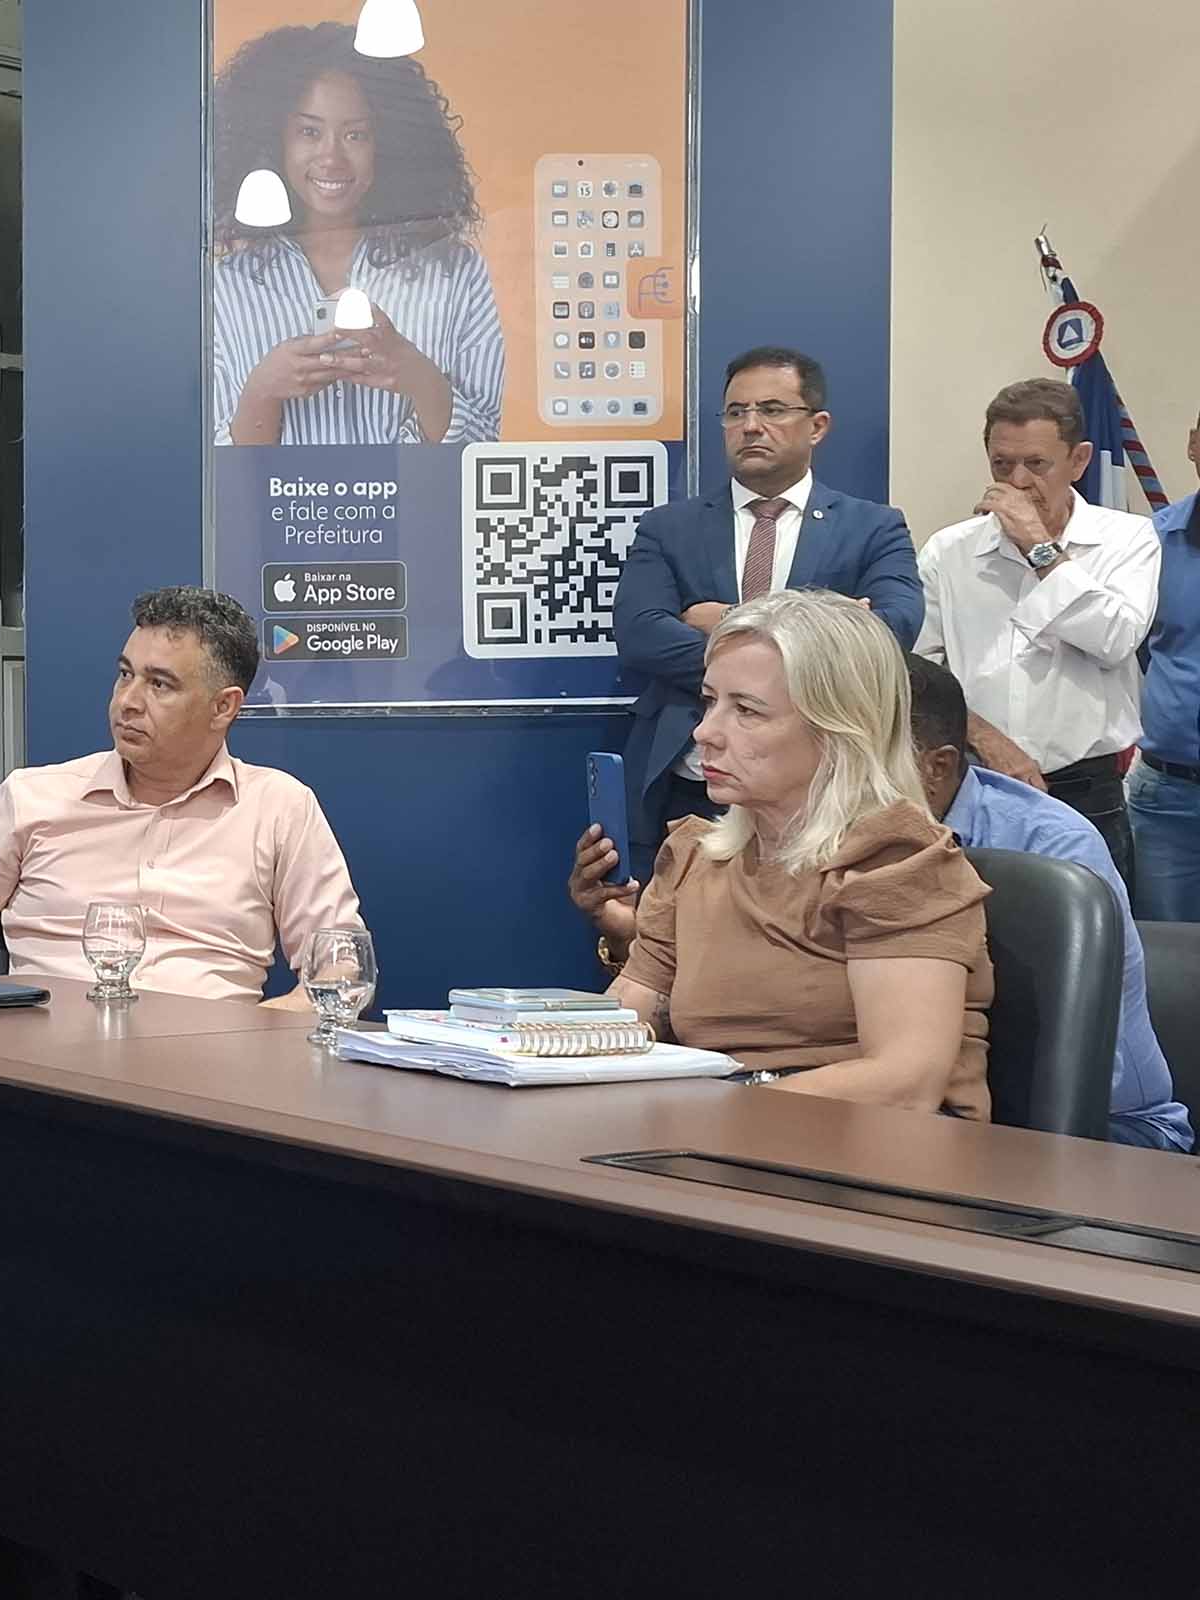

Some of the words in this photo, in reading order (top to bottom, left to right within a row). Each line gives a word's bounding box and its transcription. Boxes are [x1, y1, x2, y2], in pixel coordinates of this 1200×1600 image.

[269, 477, 328, 497] Baixe
[334, 482, 348, 496] o
[353, 481, 397, 500] app
[271, 506, 284, 520] e
[288, 500, 329, 520] fale
[333, 505, 376, 520] com
[382, 505, 395, 519] a
[285, 524, 383, 544] Prefeitura
[304, 571, 336, 582] Baixar
[338, 573, 352, 582] na
[303, 584, 342, 605] App
[346, 583, 396, 601] Store
[306, 621, 360, 633] DISPONÍVEL
[362, 622, 376, 632] NO
[306, 634, 364, 655] Google
[366, 634, 399, 654] Play
